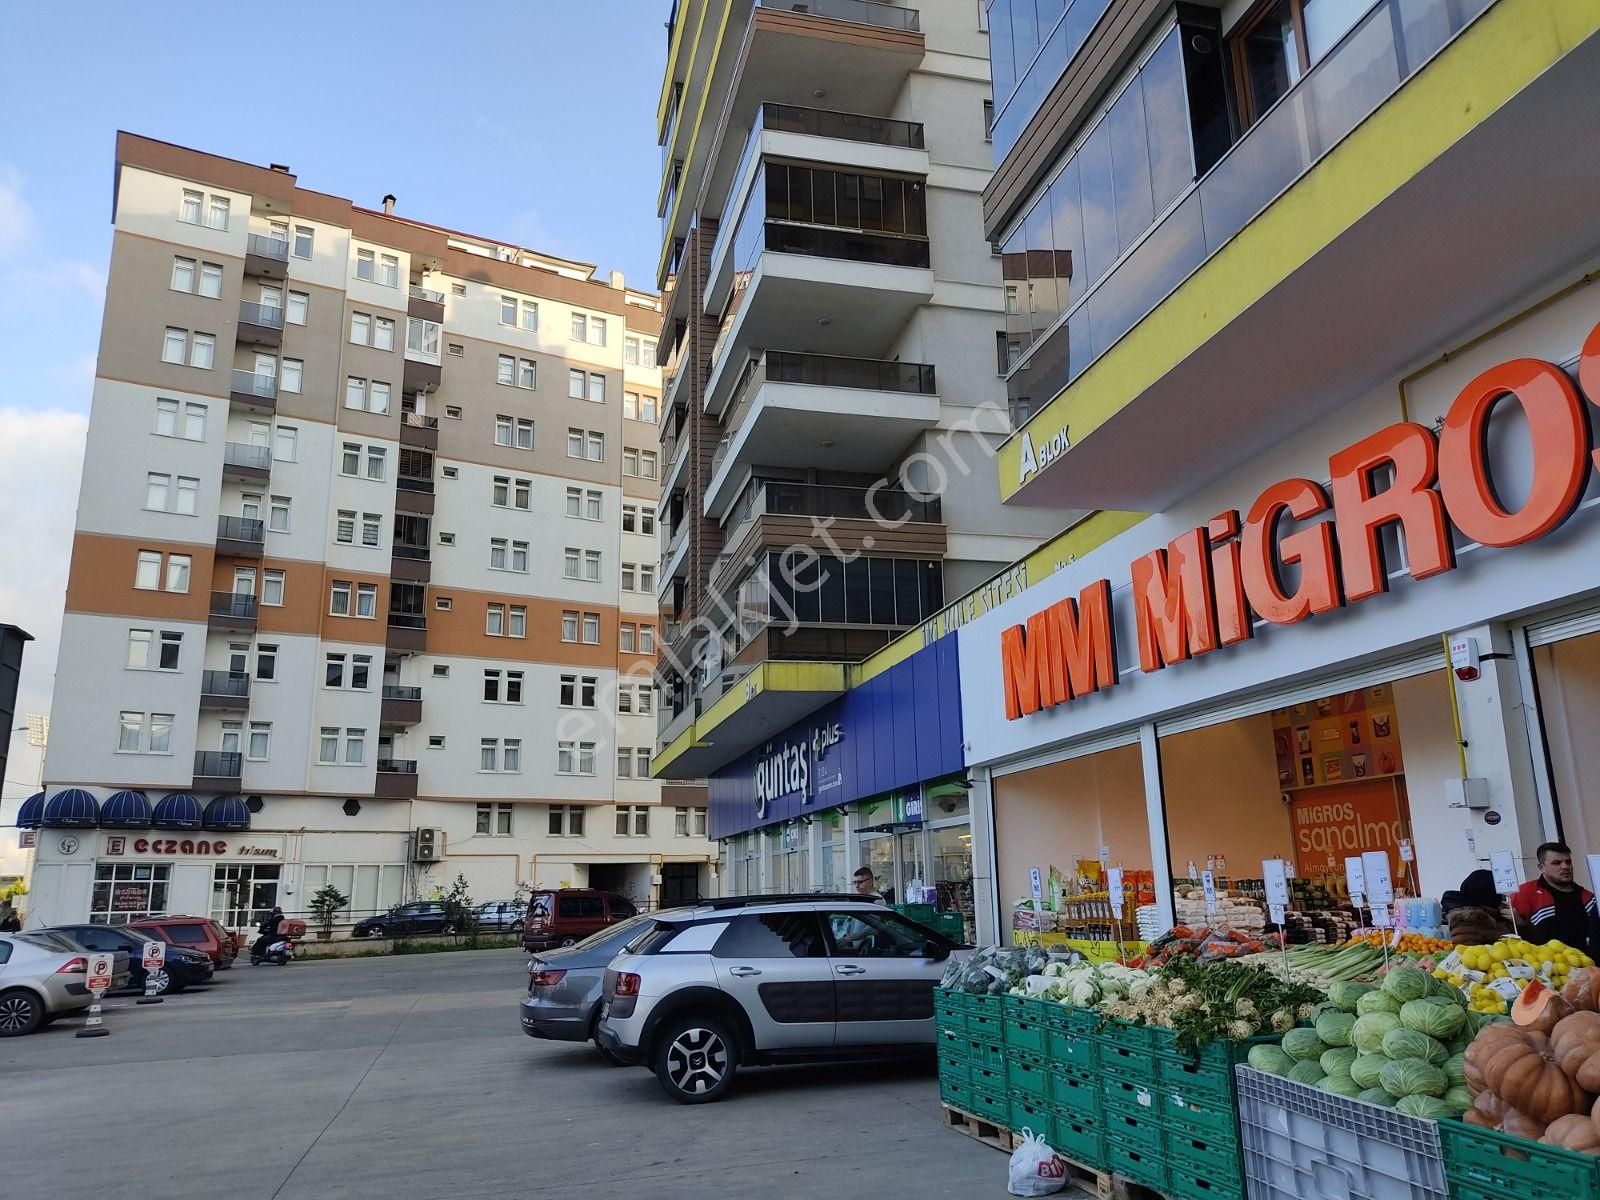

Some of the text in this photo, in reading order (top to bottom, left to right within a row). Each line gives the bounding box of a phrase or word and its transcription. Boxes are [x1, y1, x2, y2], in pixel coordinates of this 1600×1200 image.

[1019, 424, 1071, 485] A BLOK
[1001, 578, 1119, 721] MM
[756, 722, 840, 819] güntaş plus
[134, 838, 228, 855] eczane
